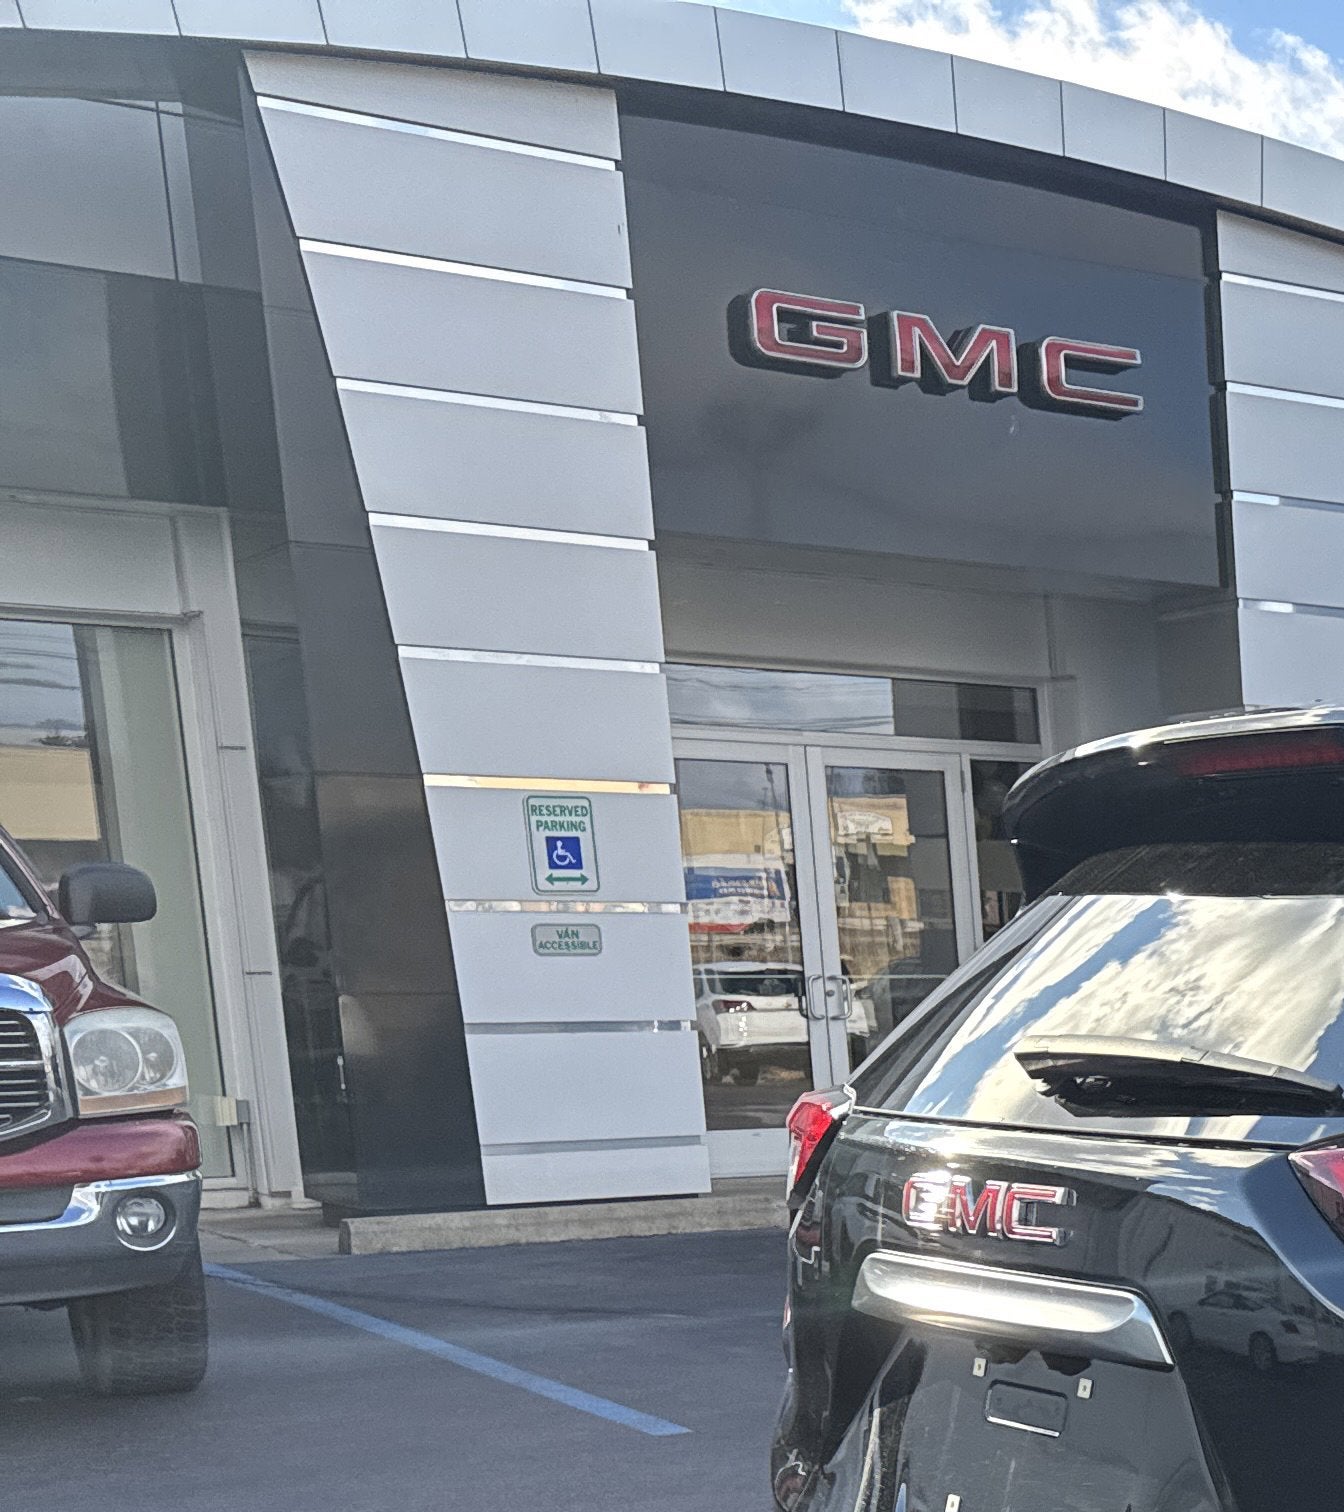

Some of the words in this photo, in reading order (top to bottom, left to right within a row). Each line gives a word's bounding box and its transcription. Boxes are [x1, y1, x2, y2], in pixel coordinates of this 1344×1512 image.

[749, 287, 1144, 412] GMC
[530, 804, 589, 818] RESERVED
[535, 820, 587, 833] PARKING
[556, 928, 580, 940] VAN
[537, 940, 599, 951] ACCESSIBLE
[902, 1169, 1074, 1246] GMC
